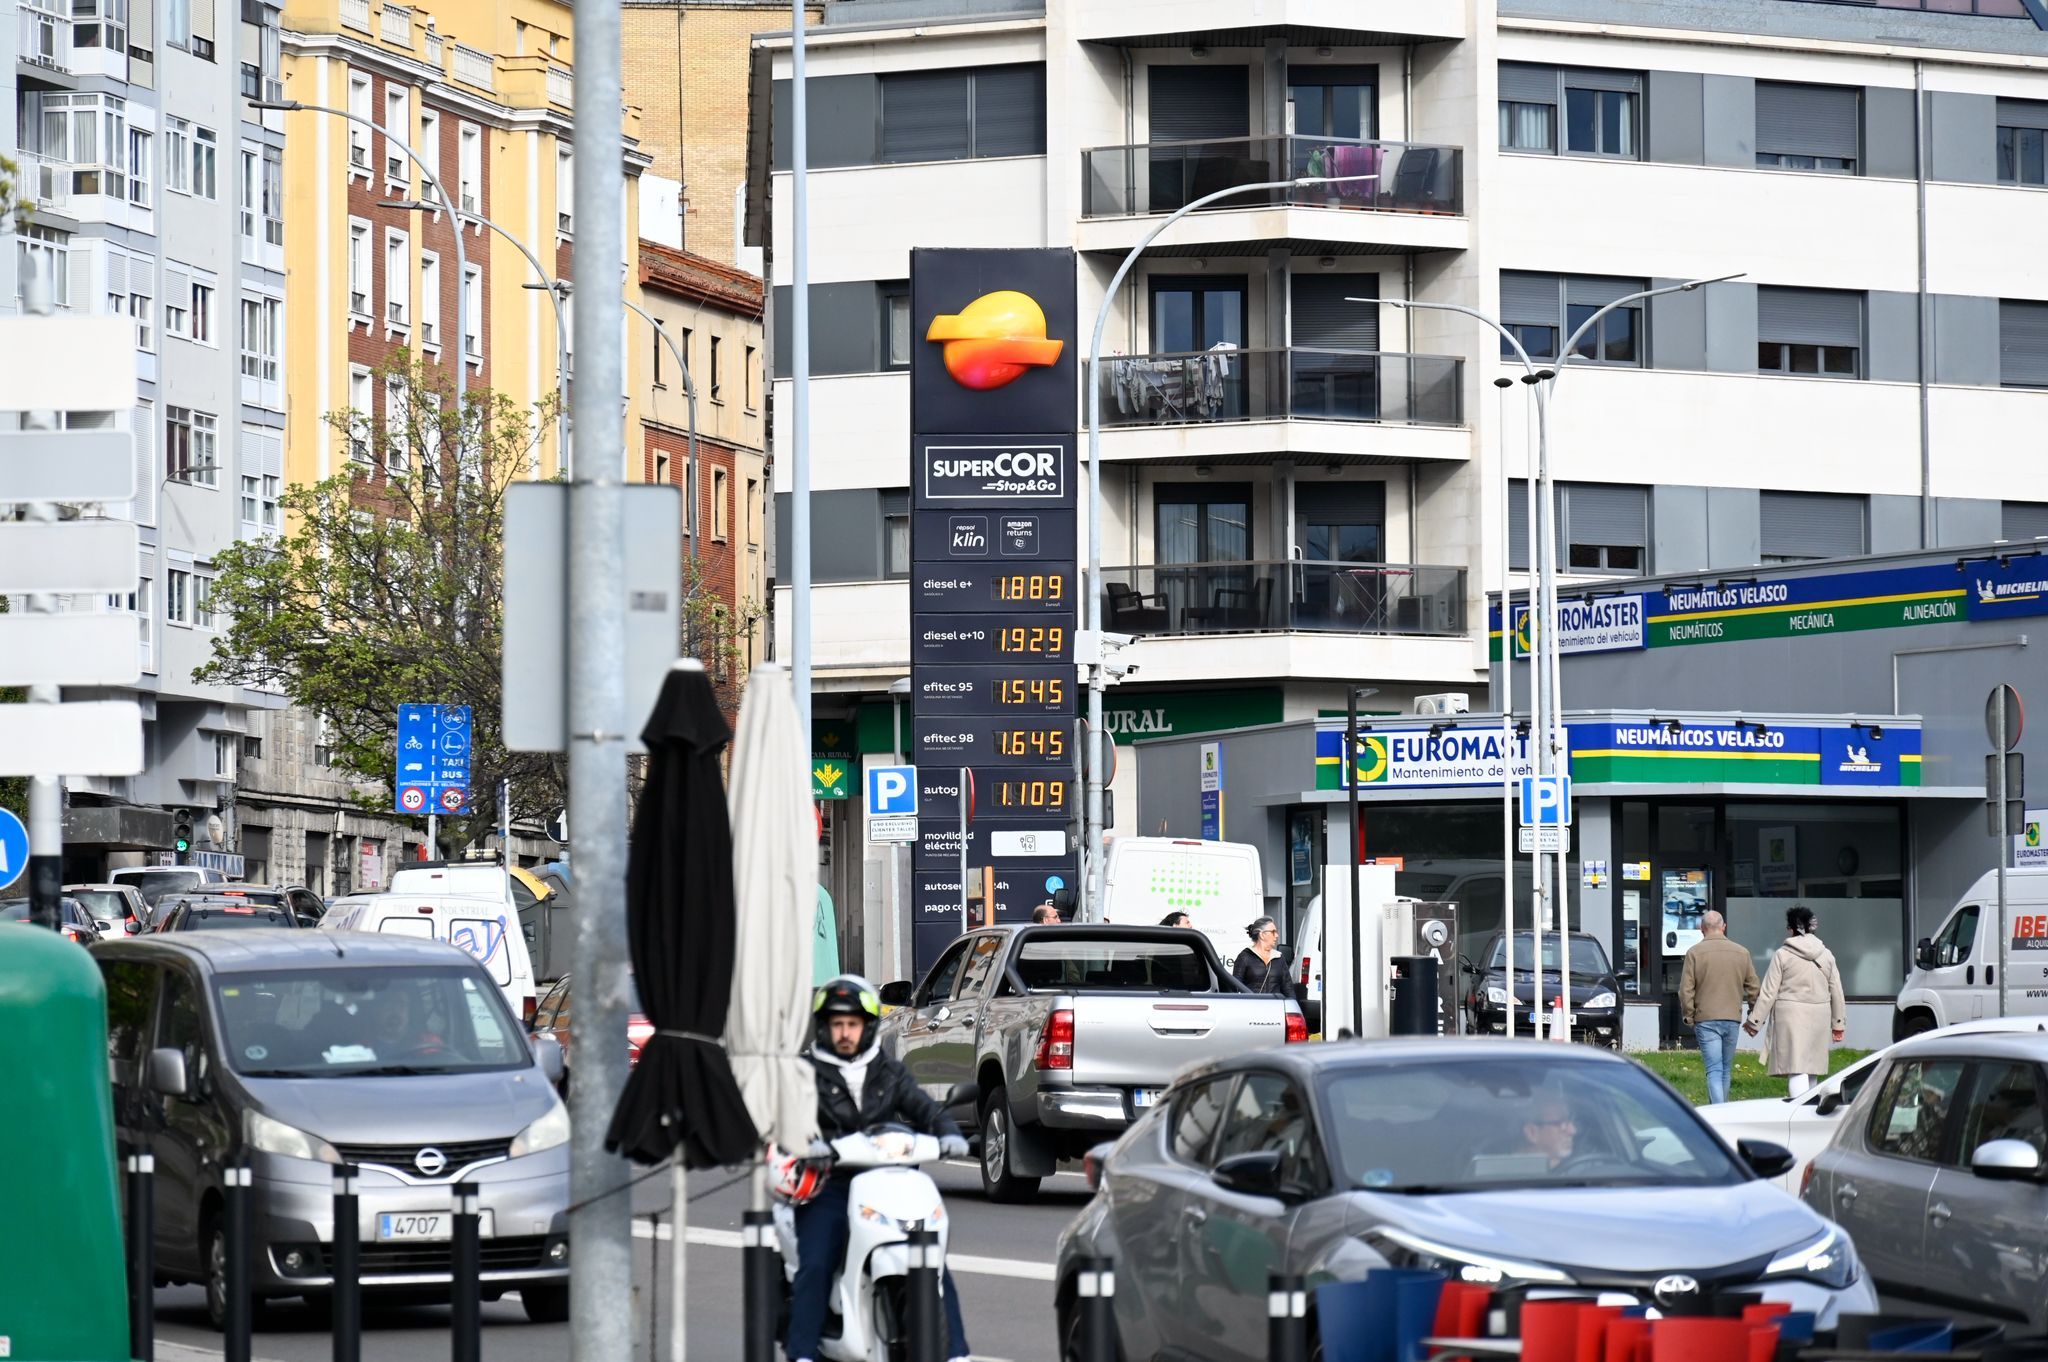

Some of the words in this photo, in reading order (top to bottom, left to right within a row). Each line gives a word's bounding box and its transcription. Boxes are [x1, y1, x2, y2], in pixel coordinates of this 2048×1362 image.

[933, 452, 1056, 477] SUPERCOR
[996, 480, 1057, 494] Stop&Go
[953, 532, 985, 547] klin
[923, 579, 957, 589] diesel
[959, 580, 972, 589] e+
[1001, 575, 1062, 600] 1.889
[1669, 588, 1738, 611] NEUMÁTICOS
[1740, 584, 1788, 605] VELASCO
[1557, 601, 1639, 633] ROMASTER
[1903, 599, 1956, 621] ALINEACIÓN
[1790, 611, 1834, 630] MECÁNICA
[923, 630, 957, 640] diesel
[959, 630, 985, 640] e+10
[1001, 628, 1062, 652] 1.929
[1597, 631, 1608, 644] del
[1609, 630, 1640, 643] vehículo
[1669, 621, 1723, 641] NEUMÁTICOS
[923, 681, 957, 692] efitec
[958, 682, 973, 692] 95
[1001, 679, 1063, 703] 1.545
[1102, 709, 1172, 733] URAL
[923, 733, 957, 743] efitec
[958, 733, 974, 743] 98
[1001, 731, 1063, 755] 1.645
[1717, 730, 1784, 748] VELASCO
[442, 758, 464, 767] TAXI
[1393, 766, 1484, 779] Mantenimiento
[1488, 764, 1504, 776] de
[441, 771, 463, 779] BUS
[406, 795, 420, 803] 30
[877, 773, 907, 811] P
[1002, 782, 1063, 806] 1.109
[924, 831, 974, 840] movilidd
[924, 903, 950, 913] pago
[2014, 915, 2048, 939] IBE
[394, 1216, 439, 1235] 4707
